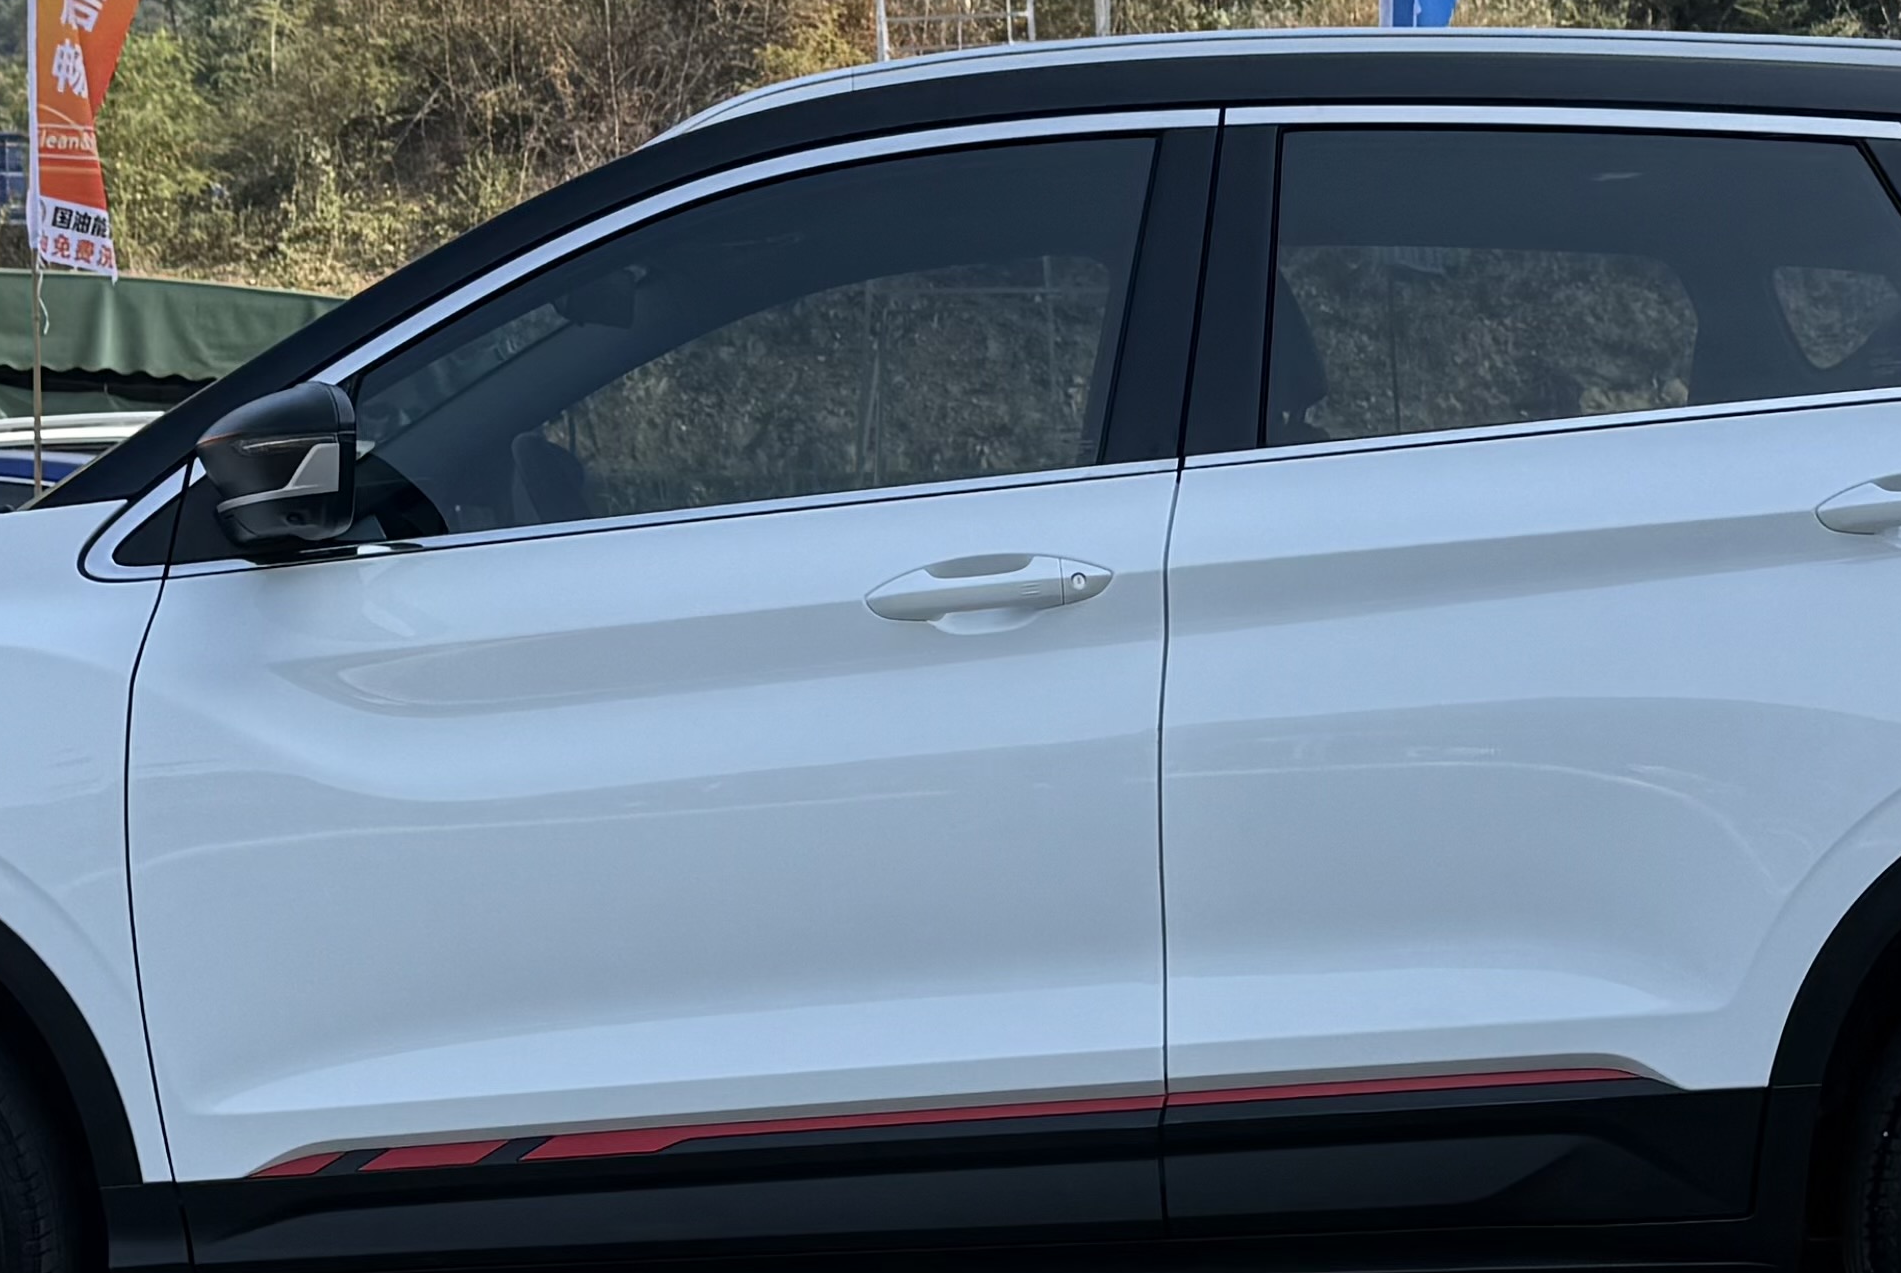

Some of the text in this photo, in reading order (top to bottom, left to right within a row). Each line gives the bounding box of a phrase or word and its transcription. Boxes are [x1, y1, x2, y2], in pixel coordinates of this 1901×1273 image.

[40, 129, 96, 151] lean&
[51, 205, 110, 239] 国油能
